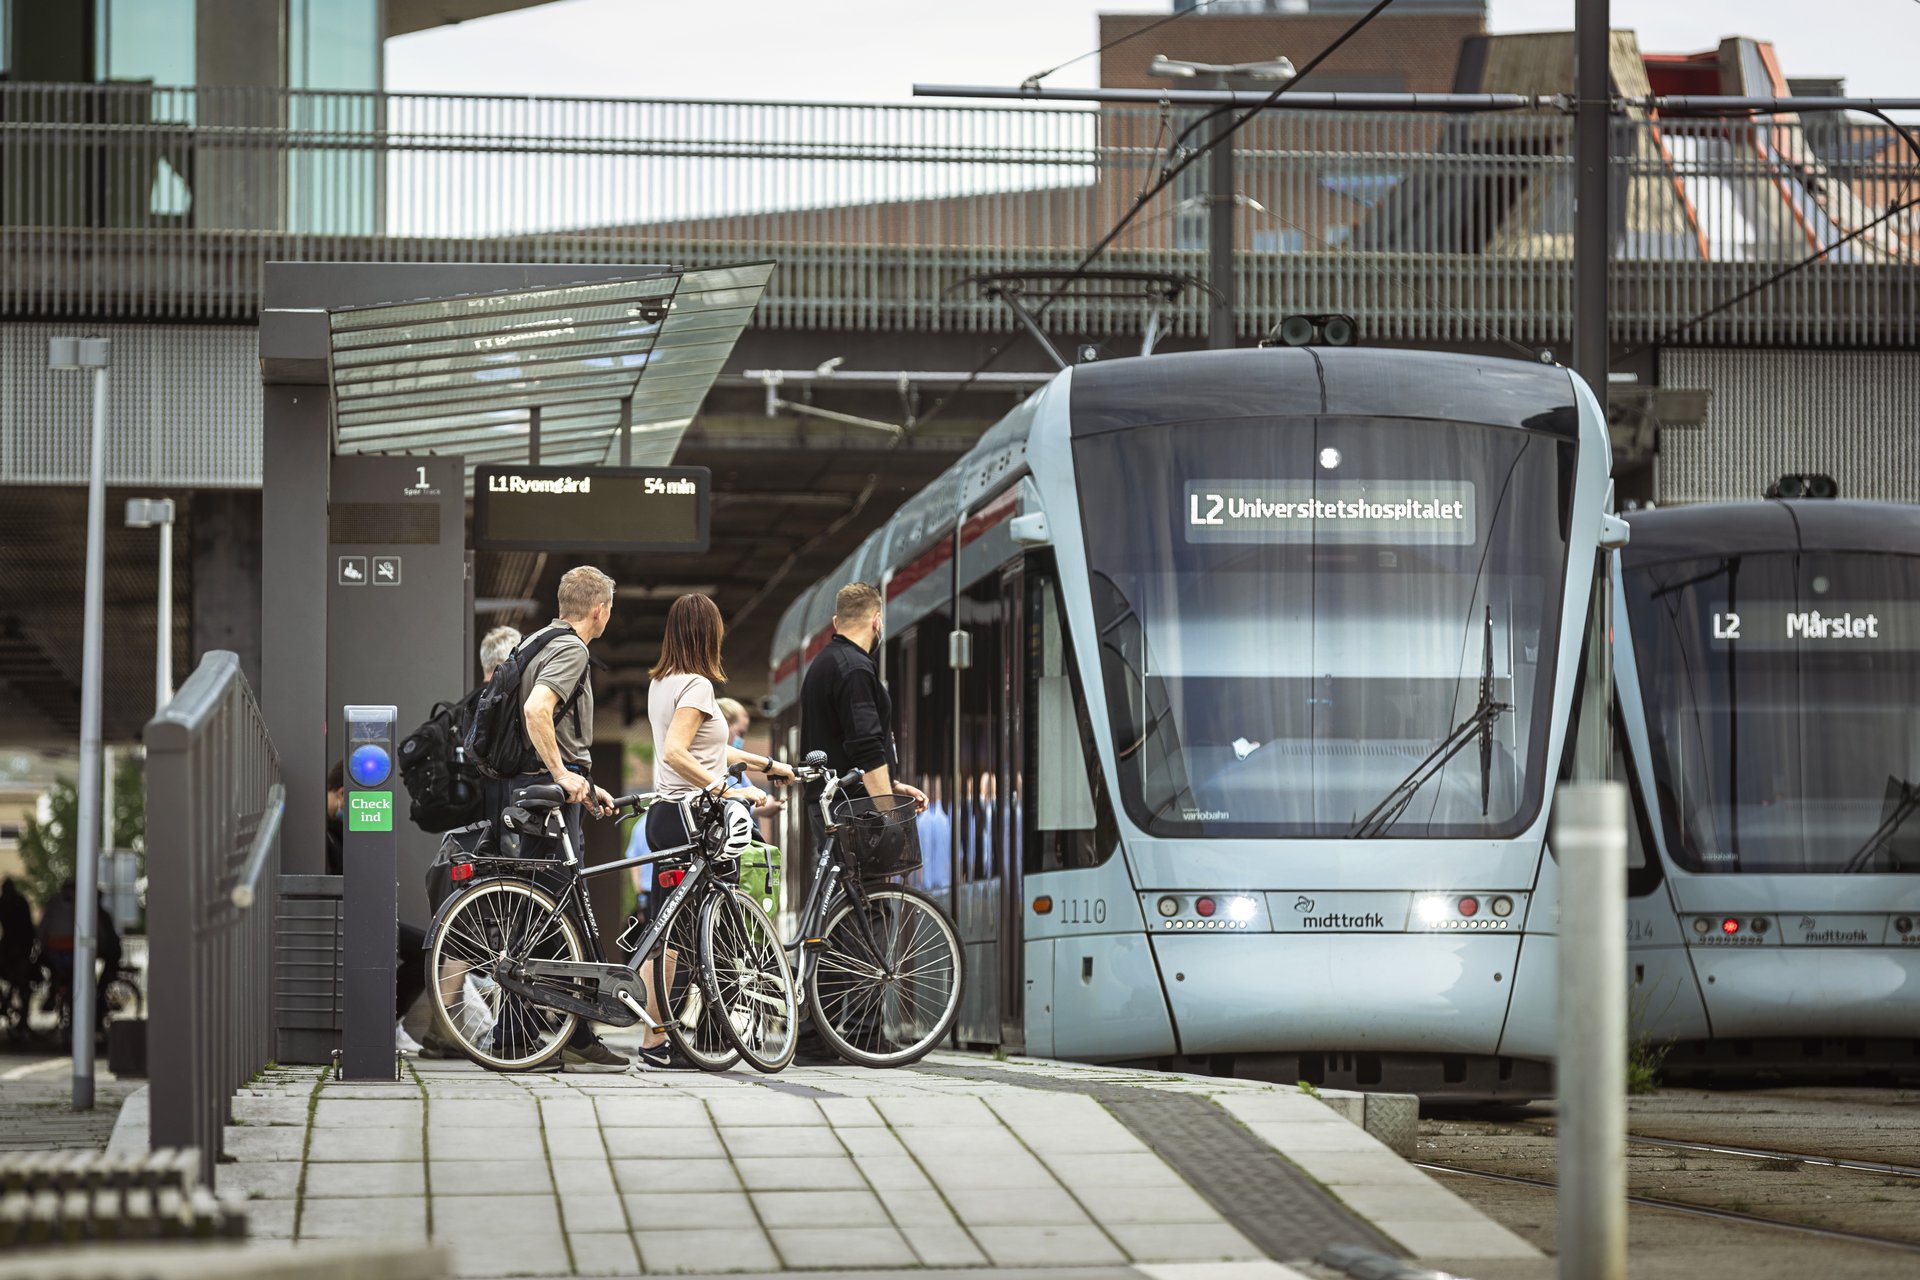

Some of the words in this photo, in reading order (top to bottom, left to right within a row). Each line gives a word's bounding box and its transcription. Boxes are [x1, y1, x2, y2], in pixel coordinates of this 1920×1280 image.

[415, 466, 430, 489] 1
[489, 475, 508, 492] L1
[509, 475, 591, 494] Ryomgård
[644, 477, 666, 494] 54
[666, 478, 696, 495] min
[1190, 494, 1224, 525] L2
[1228, 498, 1463, 520] Universitetshospitalet
[1713, 612, 1741, 639] L2
[1786, 610, 1879, 639] Mårslet
[351, 798, 391, 809] Check
[360, 811, 381, 822] ind
[1183, 809, 1230, 821] variobahn
[1060, 898, 1107, 924] 1110
[1303, 912, 1384, 928] midttrafik
